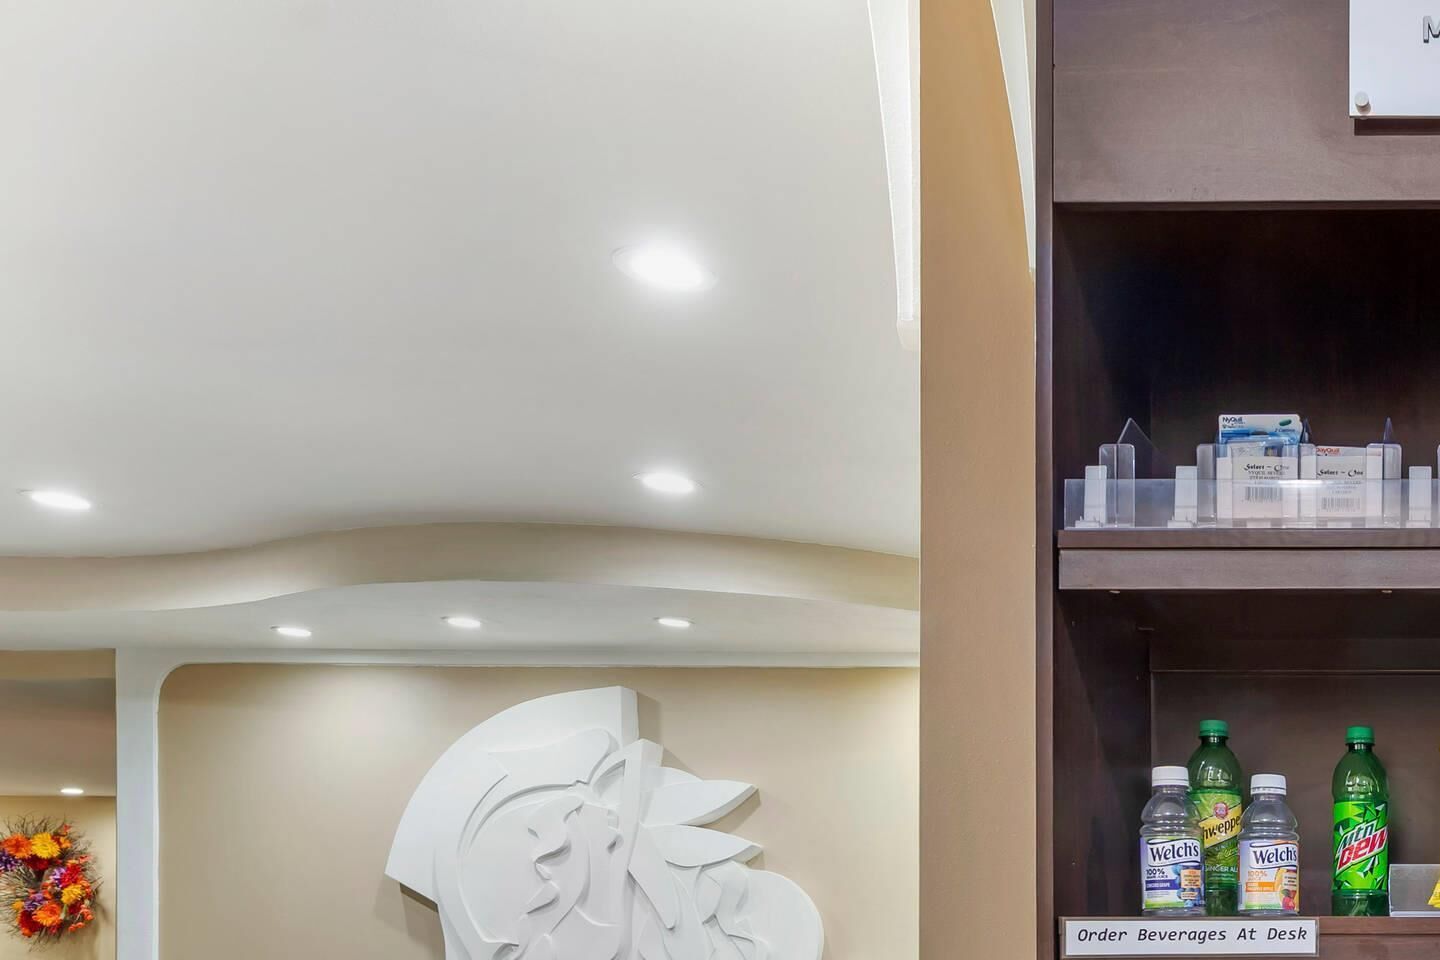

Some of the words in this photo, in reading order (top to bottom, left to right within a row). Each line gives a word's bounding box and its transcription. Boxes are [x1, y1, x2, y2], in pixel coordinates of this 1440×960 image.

[1150, 843, 1199, 862] Welch's
[1253, 847, 1297, 865] Welch's
[1077, 928, 1127, 942] Order
[1138, 928, 1226, 944] Beverages
[1237, 928, 1256, 940] At
[1267, 926, 1307, 940] Desk
